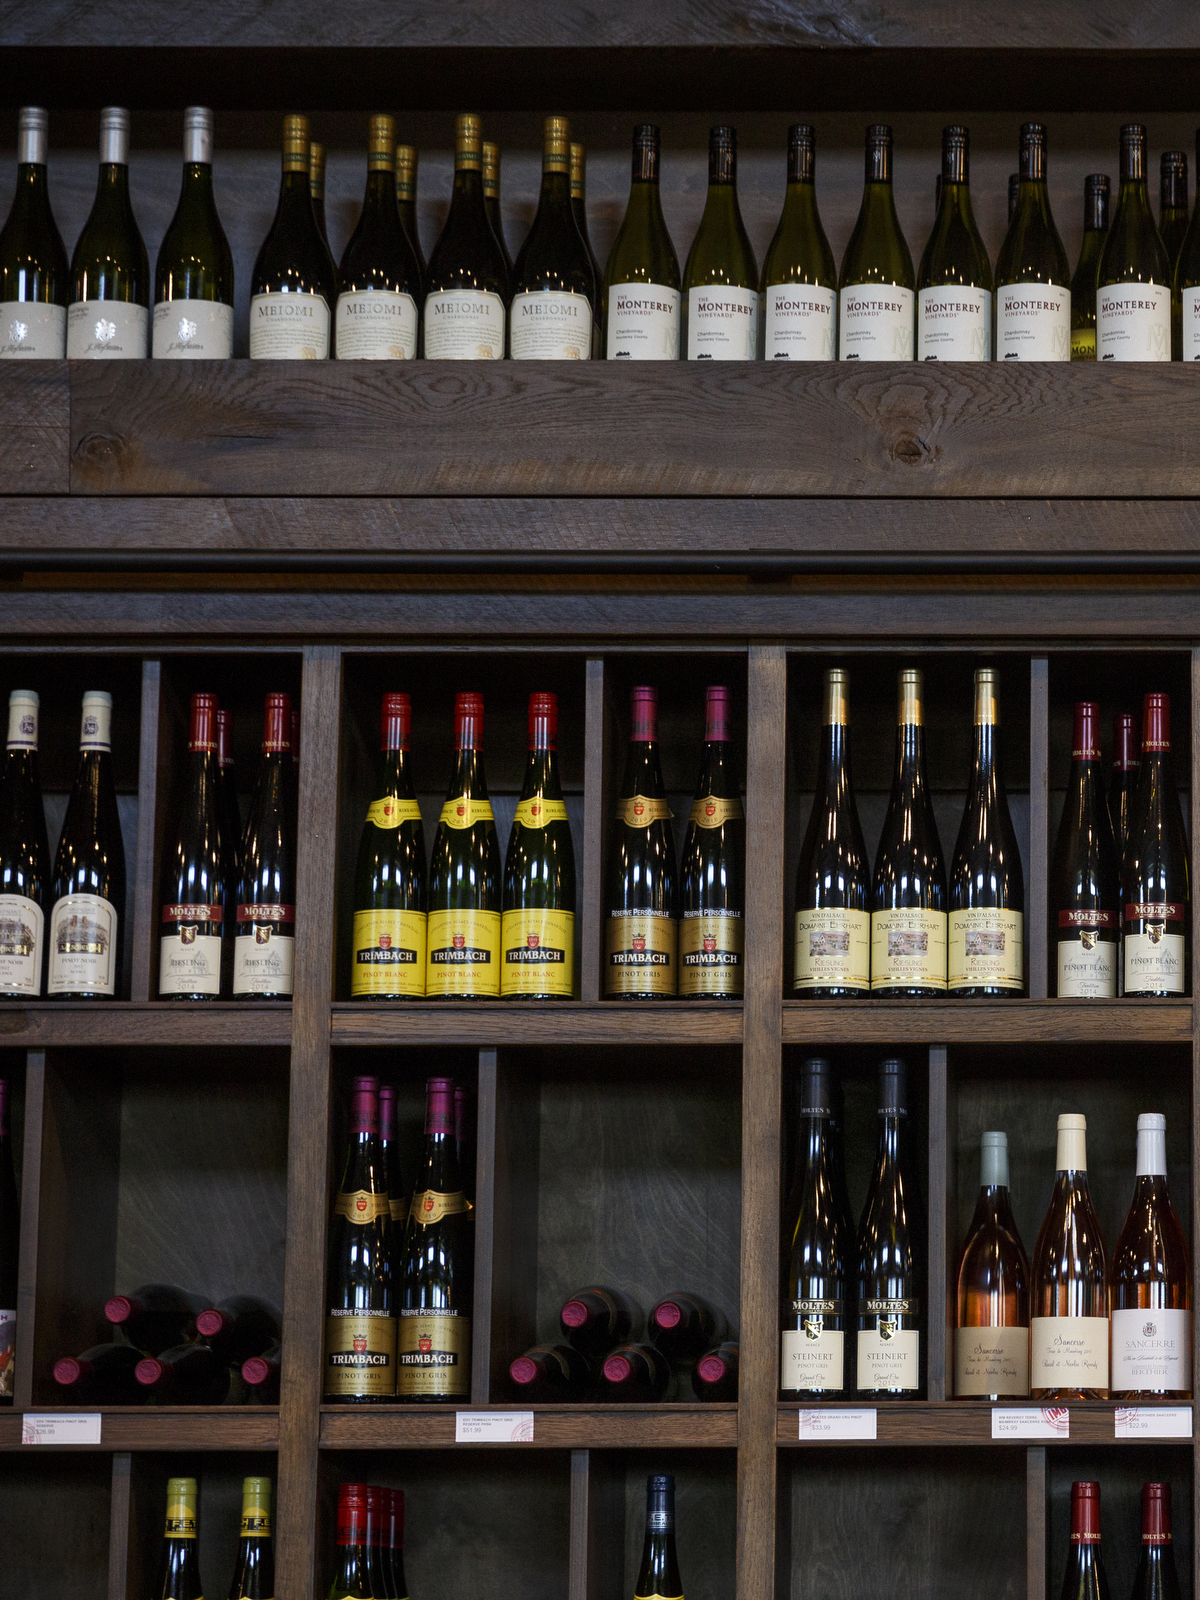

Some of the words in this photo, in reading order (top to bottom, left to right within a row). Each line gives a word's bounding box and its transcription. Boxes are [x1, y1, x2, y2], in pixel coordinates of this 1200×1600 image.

[346, 304, 402, 316] MEIOMI
[434, 302, 490, 315] MEIOMI
[522, 304, 578, 316] MEIOMI
[617, 300, 673, 314] MONTEREY
[698, 302, 753, 316] MONTEREY
[775, 302, 831, 315] MONTEREY
[847, 302, 903, 313] MONTEREY
[924, 303, 980, 314] MONTEREY
[1004, 300, 1061, 312] MONTEREY
[1102, 300, 1157, 312] MONTEREY
[258, 305, 313, 318] MEIOMI
[632, 908, 670, 918] PERSONNELLE
[704, 908, 741, 918] PERSONNELLE
[360, 951, 412, 962] TRIMBACH
[434, 951, 486, 962] TRIMBACH
[508, 951, 560, 961] TRIMBACH
[613, 954, 666, 964] TRIMBACH
[685, 954, 737, 964] TRIMBACH
[170, 959, 206, 967] RIESLING
[244, 959, 280, 967] RIESLING
[814, 958, 844, 966] RIESLING
[893, 958, 923, 966] RIESLING
[970, 958, 1000, 966] RIESLING
[1130, 957, 1154, 966] PINOT
[1156, 957, 1180, 966] BLANC
[1064, 964, 1088, 972] PINOT
[1089, 964, 1112, 973] BLANC
[642, 970, 661, 978] GRIS
[1054, 1334, 1086, 1346] Sancerre
[1125, 1340, 1176, 1348] SANCERRE
[974, 1344, 1004, 1354] Sancerre
[332, 1354, 386, 1365] TRIMBACH
[402, 1354, 454, 1364] TRIMBACH
[792, 1352, 833, 1361] STEINERT
[867, 1352, 908, 1361] STEINERT
